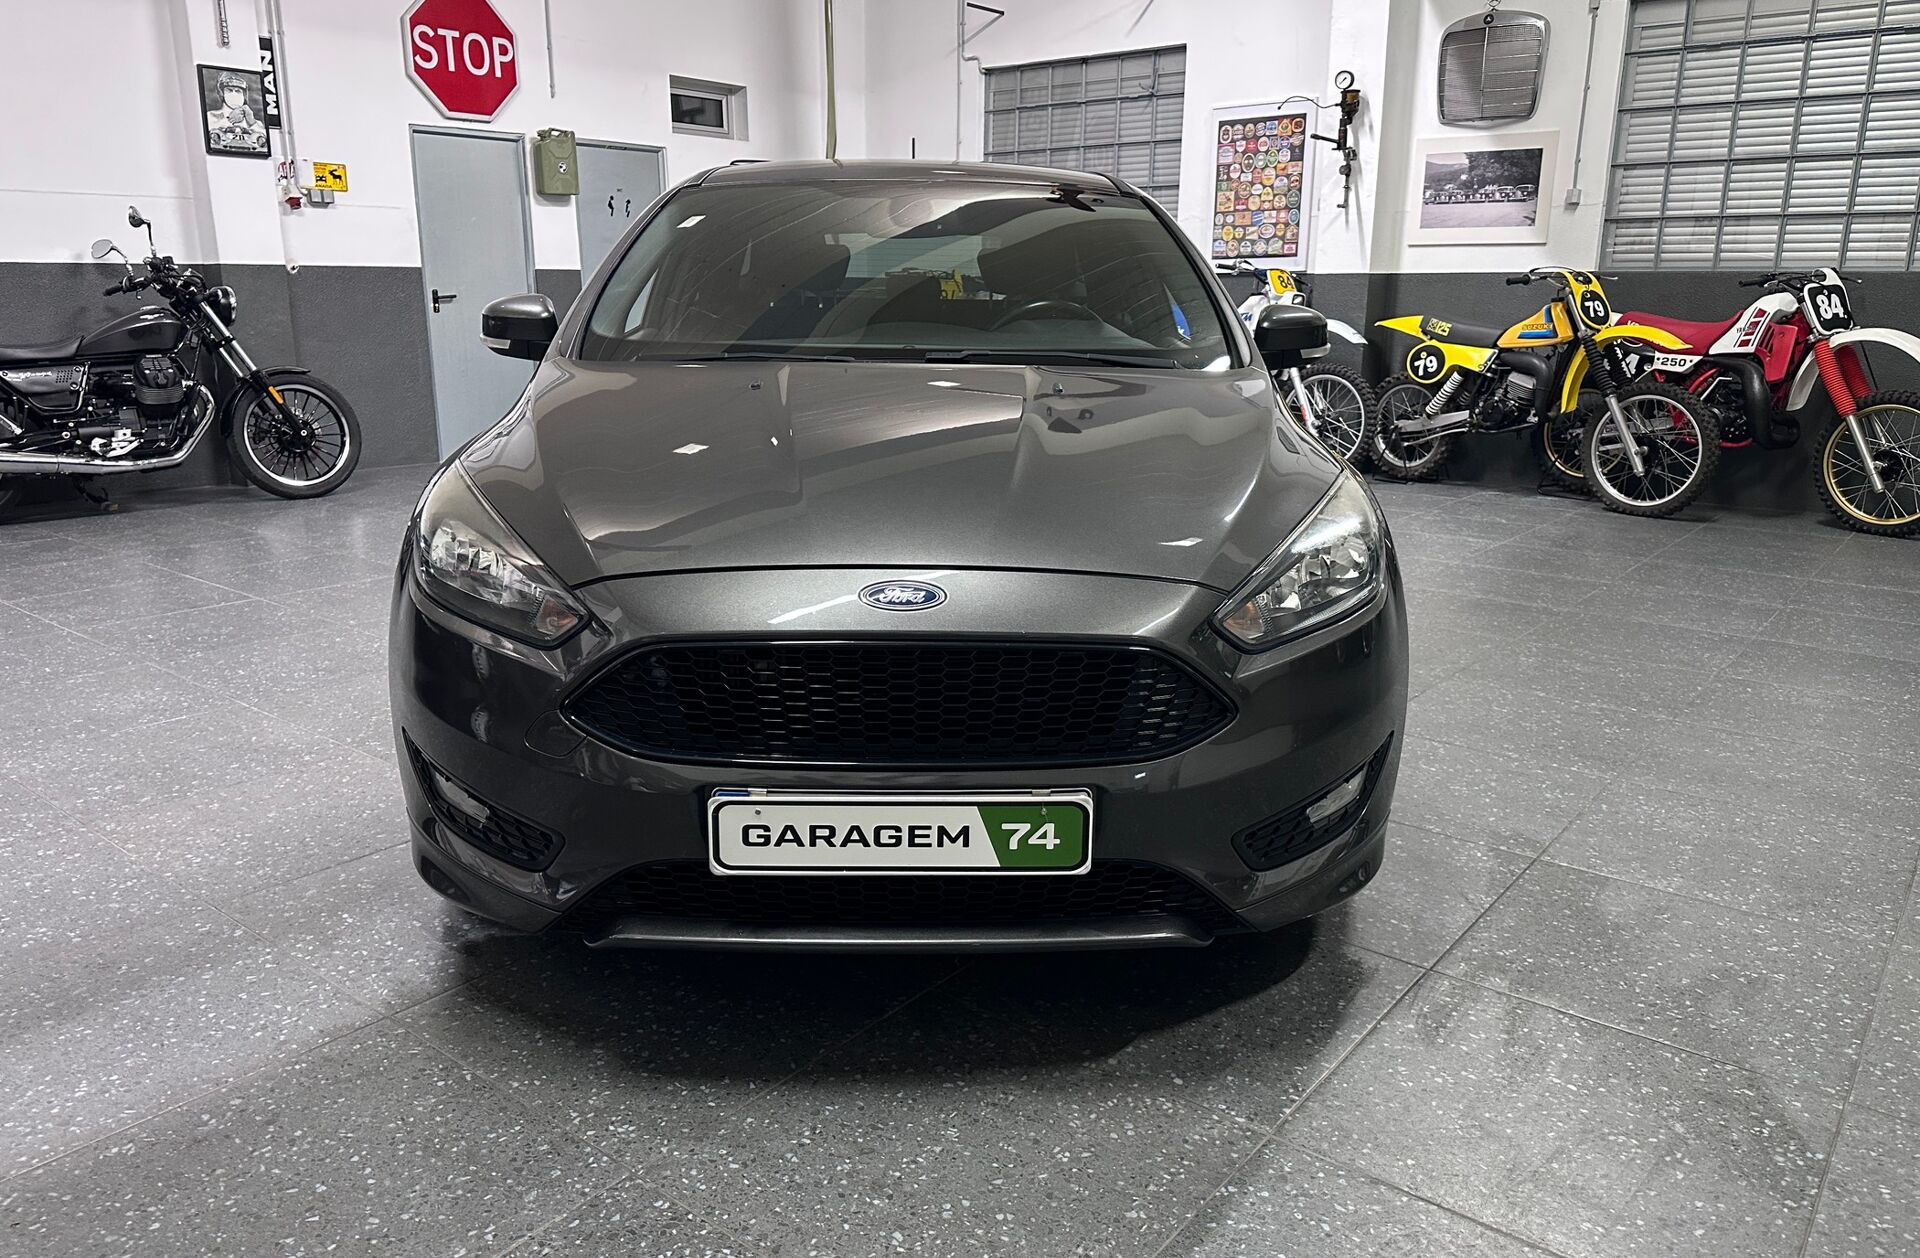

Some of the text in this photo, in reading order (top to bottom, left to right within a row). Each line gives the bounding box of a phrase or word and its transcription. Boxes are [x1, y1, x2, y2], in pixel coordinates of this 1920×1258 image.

[412, 24, 514, 78] STOP
[259, 50, 279, 115] MAN
[1277, 275, 1296, 290] 84
[1584, 300, 1606, 318] 79
[1815, 293, 1845, 320] 84
[1521, 322, 1554, 331] SUZUKI
[1413, 355, 1438, 377] 79
[1660, 356, 1687, 367] 250
[879, 586, 926, 604] Ford
[741, 823, 1061, 850] GARAGEM 74
